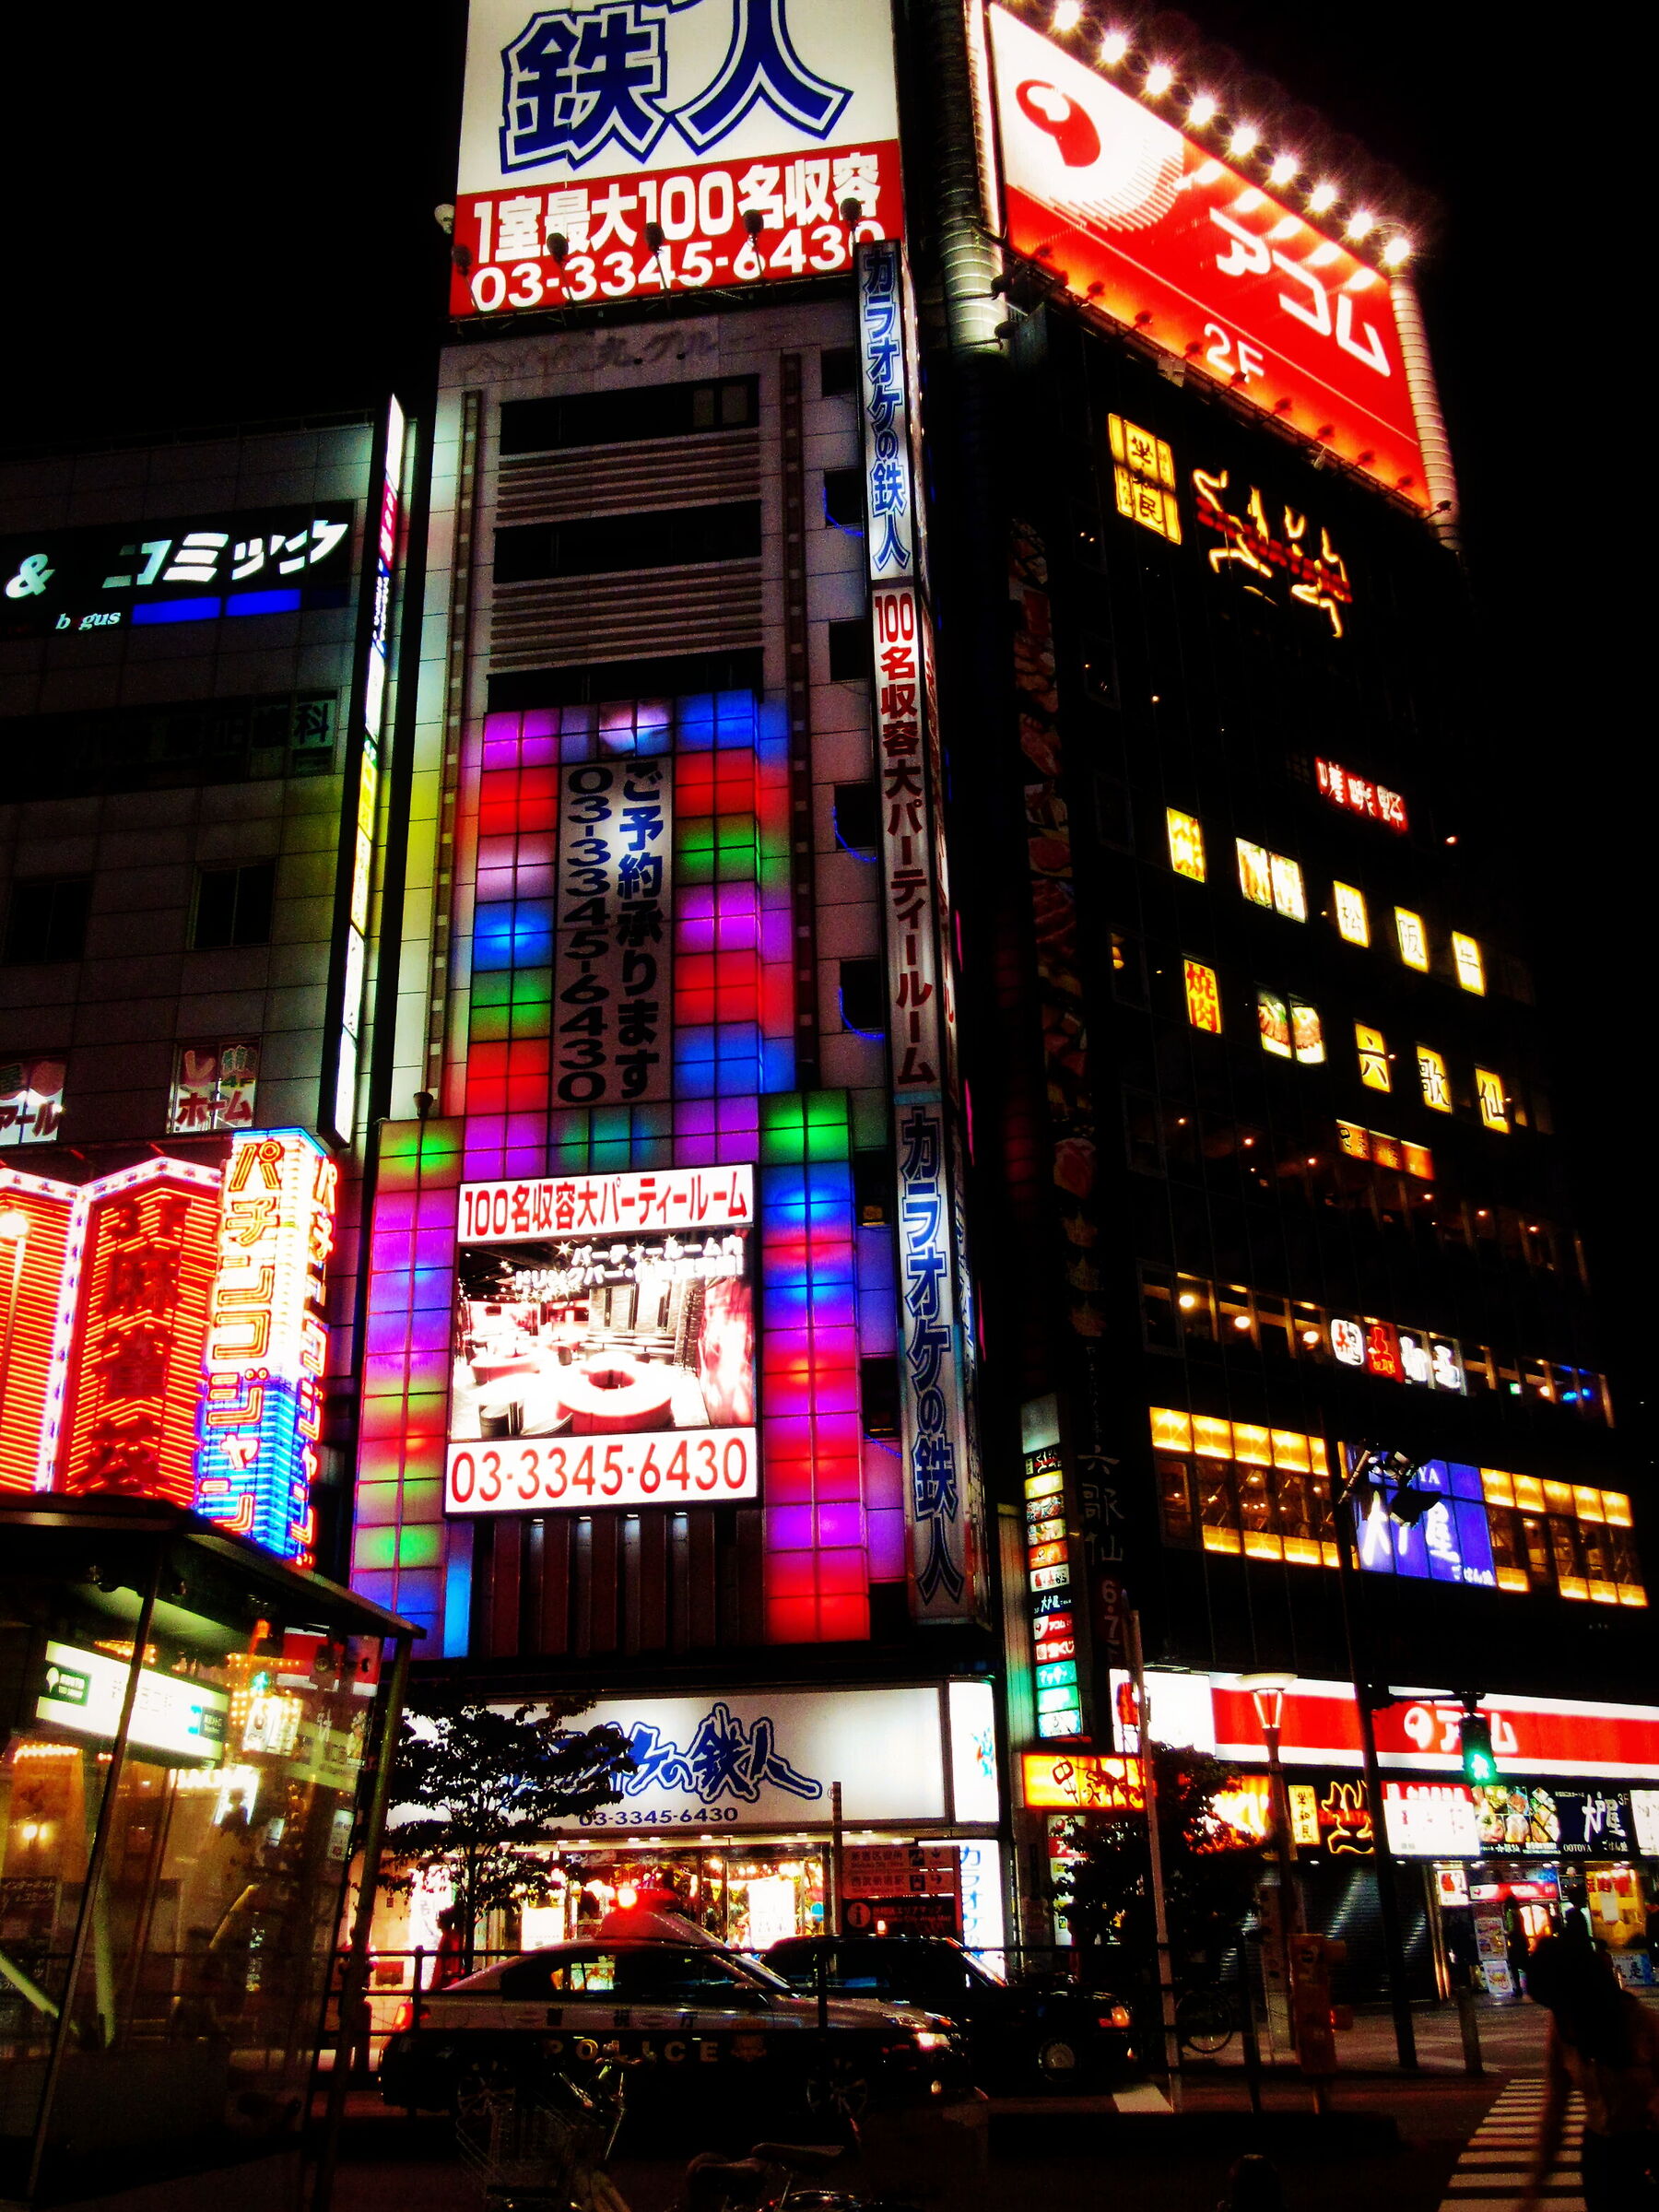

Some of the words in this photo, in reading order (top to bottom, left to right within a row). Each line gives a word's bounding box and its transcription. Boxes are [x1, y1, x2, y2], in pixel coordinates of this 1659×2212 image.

[1203, 322, 1265, 383] 2F
[863, 250, 912, 571] カラオケの鉄人
[6, 553, 56, 599] &
[101, 519, 349, 588] コミック
[55, 609, 122, 631] bgus
[615, 761, 665, 1100] ご予約承ります
[1186, 962, 1218, 1033] 焼肉
[176, 1090, 253, 1127] ホーム
[464, 1171, 749, 1237] 100名収容大パーティールーム
[899, 1110, 965, 1606] カラオケの鉄人
[1435, 1709, 1519, 1754] アム
[1581, 1791, 1627, 1843] 大戸屋
